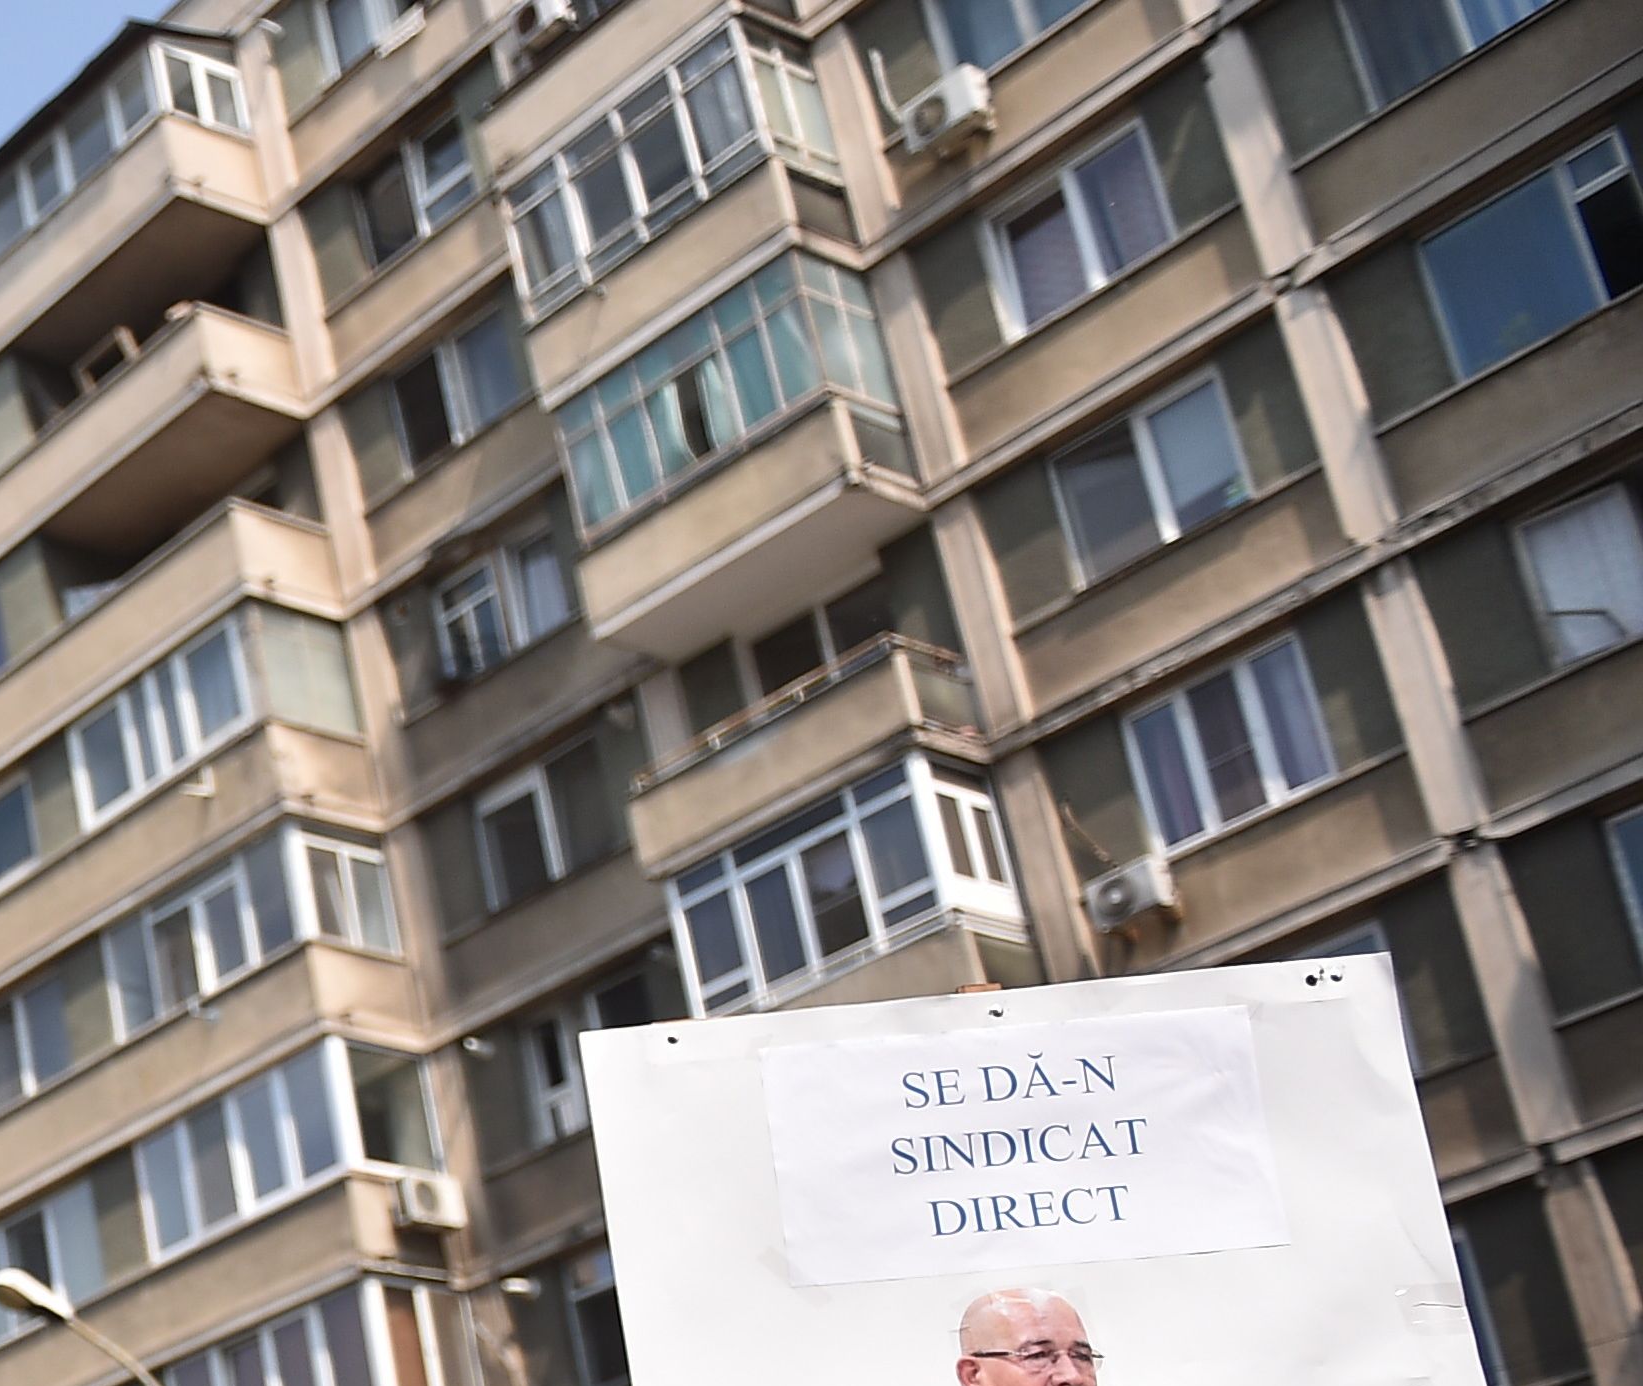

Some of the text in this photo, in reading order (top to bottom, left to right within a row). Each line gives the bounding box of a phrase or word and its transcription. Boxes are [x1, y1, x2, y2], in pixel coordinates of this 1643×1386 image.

[902, 1052, 1116, 1110] SE DĂ-N
[890, 1117, 1148, 1176] SINDICAT
[929, 1185, 1129, 1238] DIRECT
